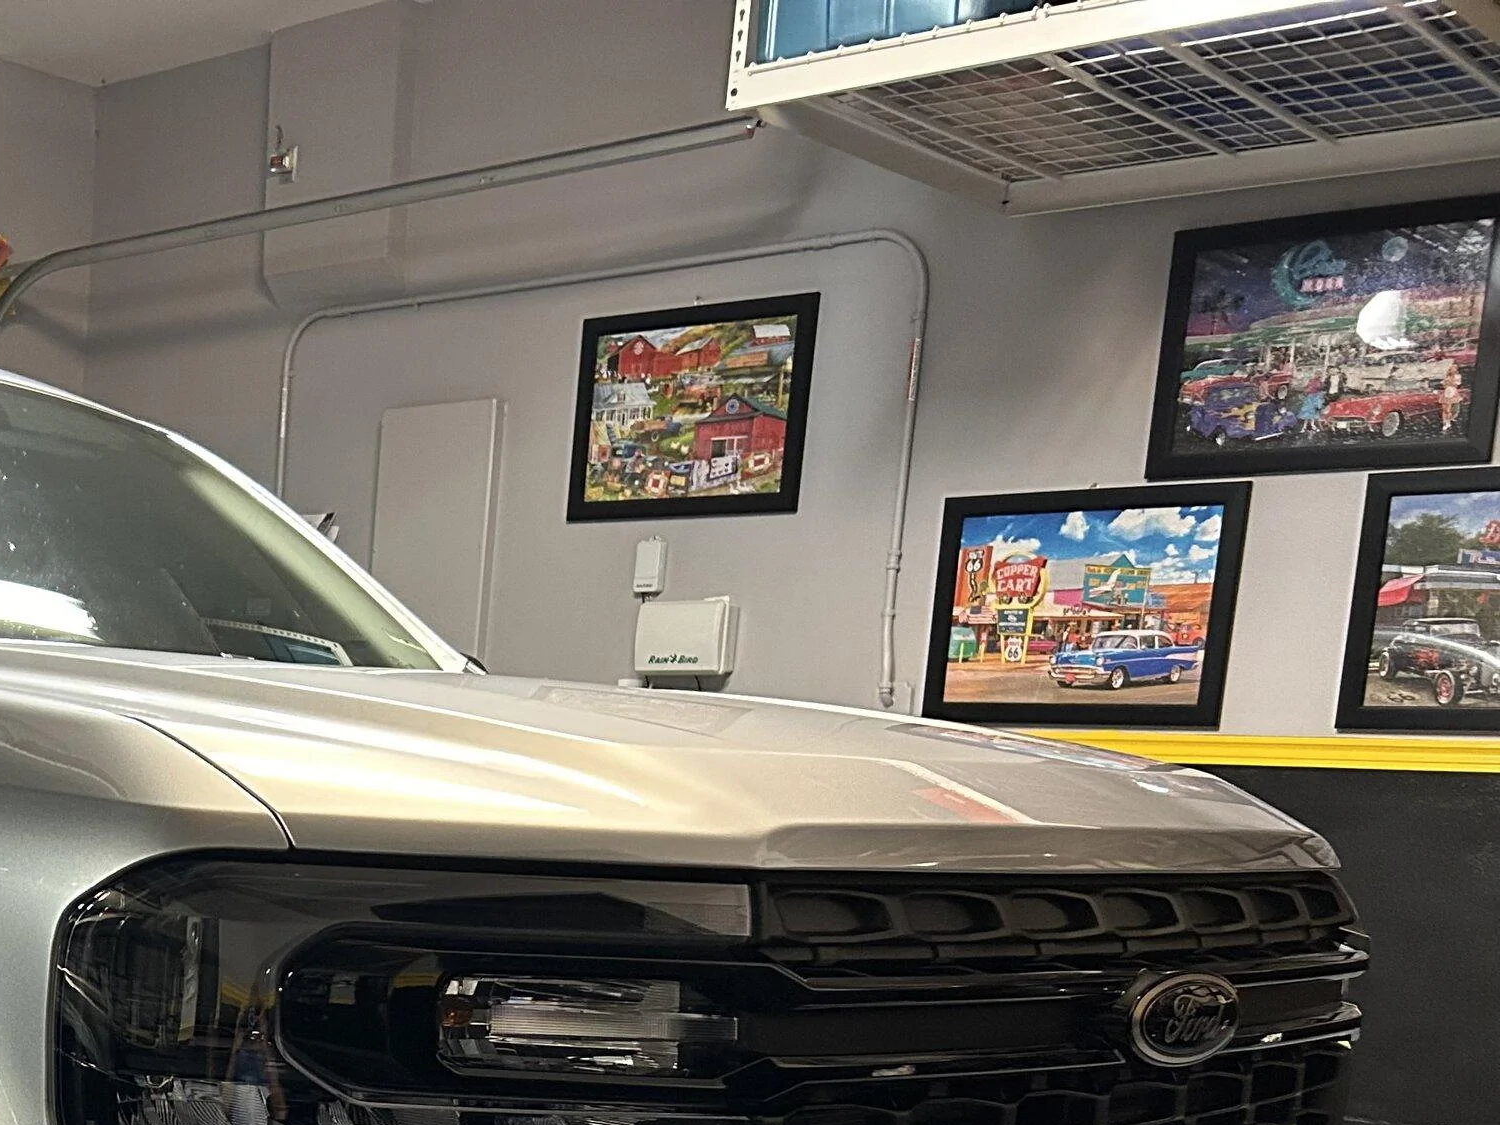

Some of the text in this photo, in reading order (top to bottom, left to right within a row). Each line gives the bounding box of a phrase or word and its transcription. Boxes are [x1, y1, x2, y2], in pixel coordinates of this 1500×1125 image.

[967, 559, 981, 572] 66
[997, 564, 1038, 579] COPPER
[997, 577, 1035, 592] CART
[1008, 647, 1019, 658] 66
[1164, 993, 1222, 1043] Ford
